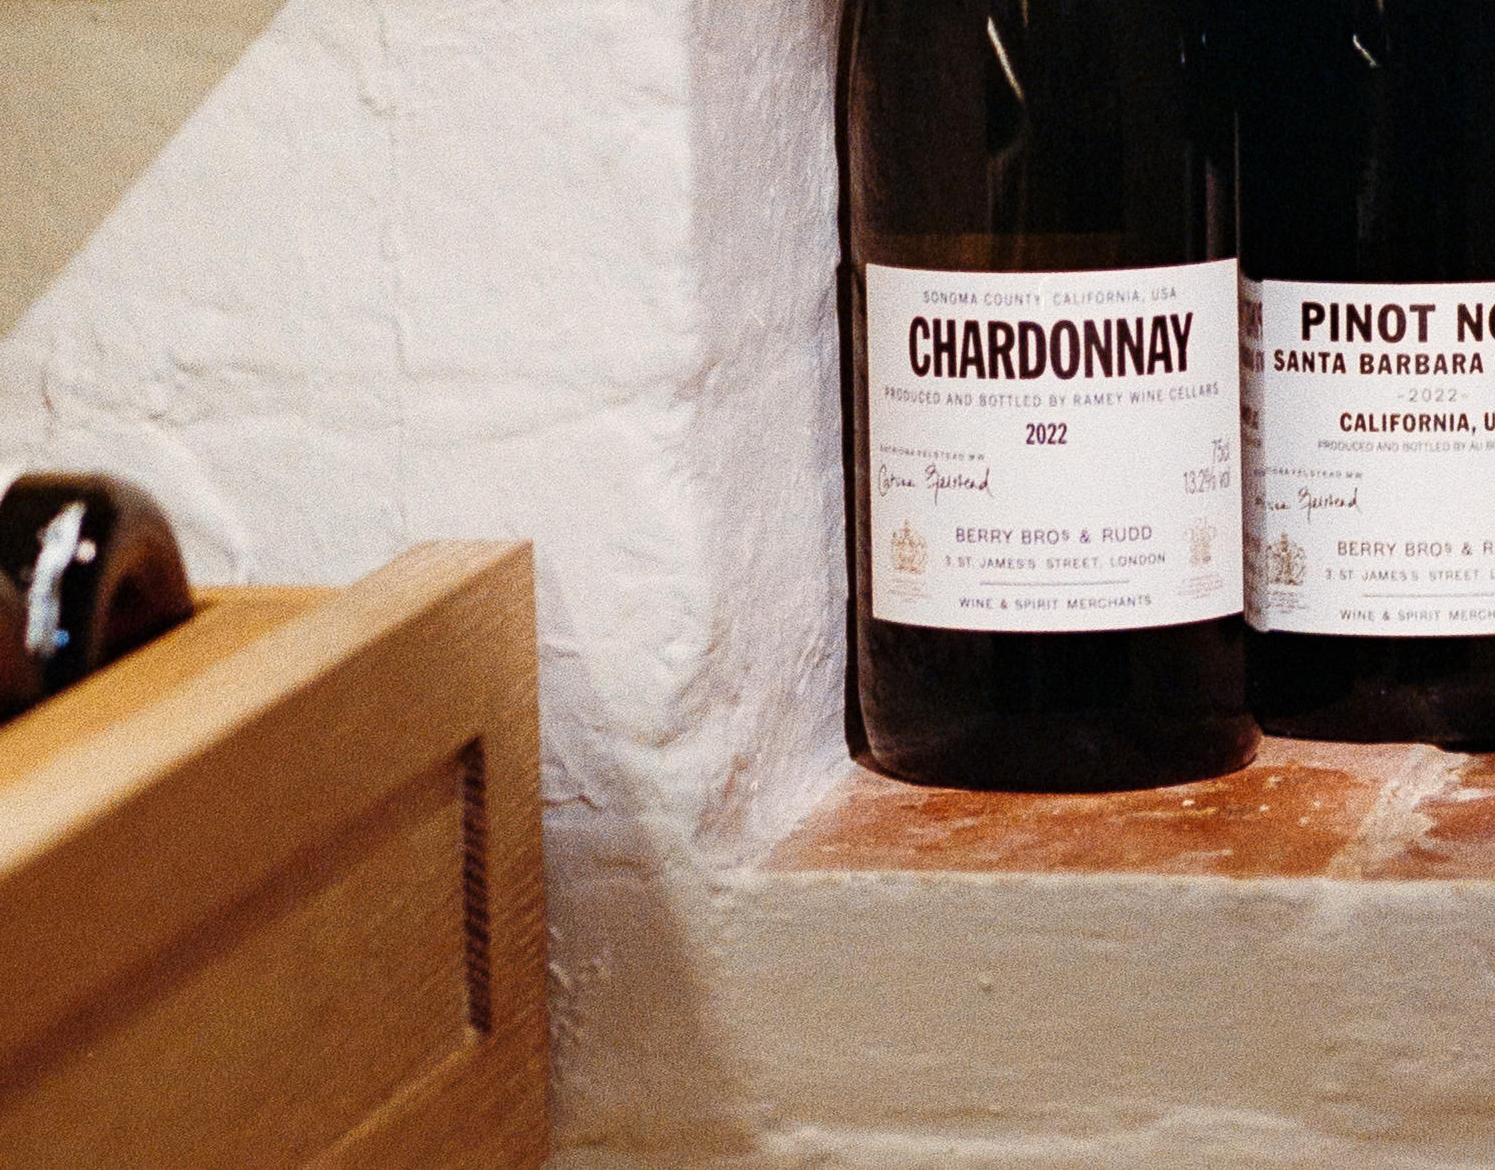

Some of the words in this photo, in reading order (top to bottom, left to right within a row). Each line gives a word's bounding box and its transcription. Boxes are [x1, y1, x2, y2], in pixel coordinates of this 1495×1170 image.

[922, 290, 978, 305] SONOMA
[1151, 286, 1177, 302] USA
[1301, 300, 1436, 343] PINOT
[908, 311, 1194, 380] CHARDONNAY
[1273, 348, 1347, 375] SANTA
[1359, 351, 1485, 376] BARBARA
[883, 385, 941, 406] PRODUCED
[946, 392, 973, 407] AND
[978, 393, 1042, 408] BOTTLED
[1048, 394, 1066, 408] BY
[1073, 391, 1123, 407] RAMEY
[1130, 388, 1162, 404] WINE
[1168, 380, 1220, 401] CELLARS
[1025, 422, 1068, 445] 2022
[1339, 412, 1477, 436] CALIFORNIA,
[1317, 437, 1374, 452] PRODUCED
[1375, 440, 1400, 452] AND
[1402, 440, 1450, 453] BOTTLED
[955, 527, 1014, 544] BERRY
[1079, 529, 1092, 544] &
[1101, 525, 1153, 543] RUDD
[1336, 540, 1398, 558] BERRY
[1461, 541, 1474, 557] &
[1109, 552, 1167, 568] LONDON
[959, 597, 993, 610] WINE
[1000, 598, 1008, 610] &
[1014, 598, 1059, 611] SPIRIT
[1066, 593, 1153, 610] MERCHANTS
[1339, 609, 1376, 623] WINE
[1381, 610, 1391, 622] &
[1397, 610, 1442, 623] SPIRIT
